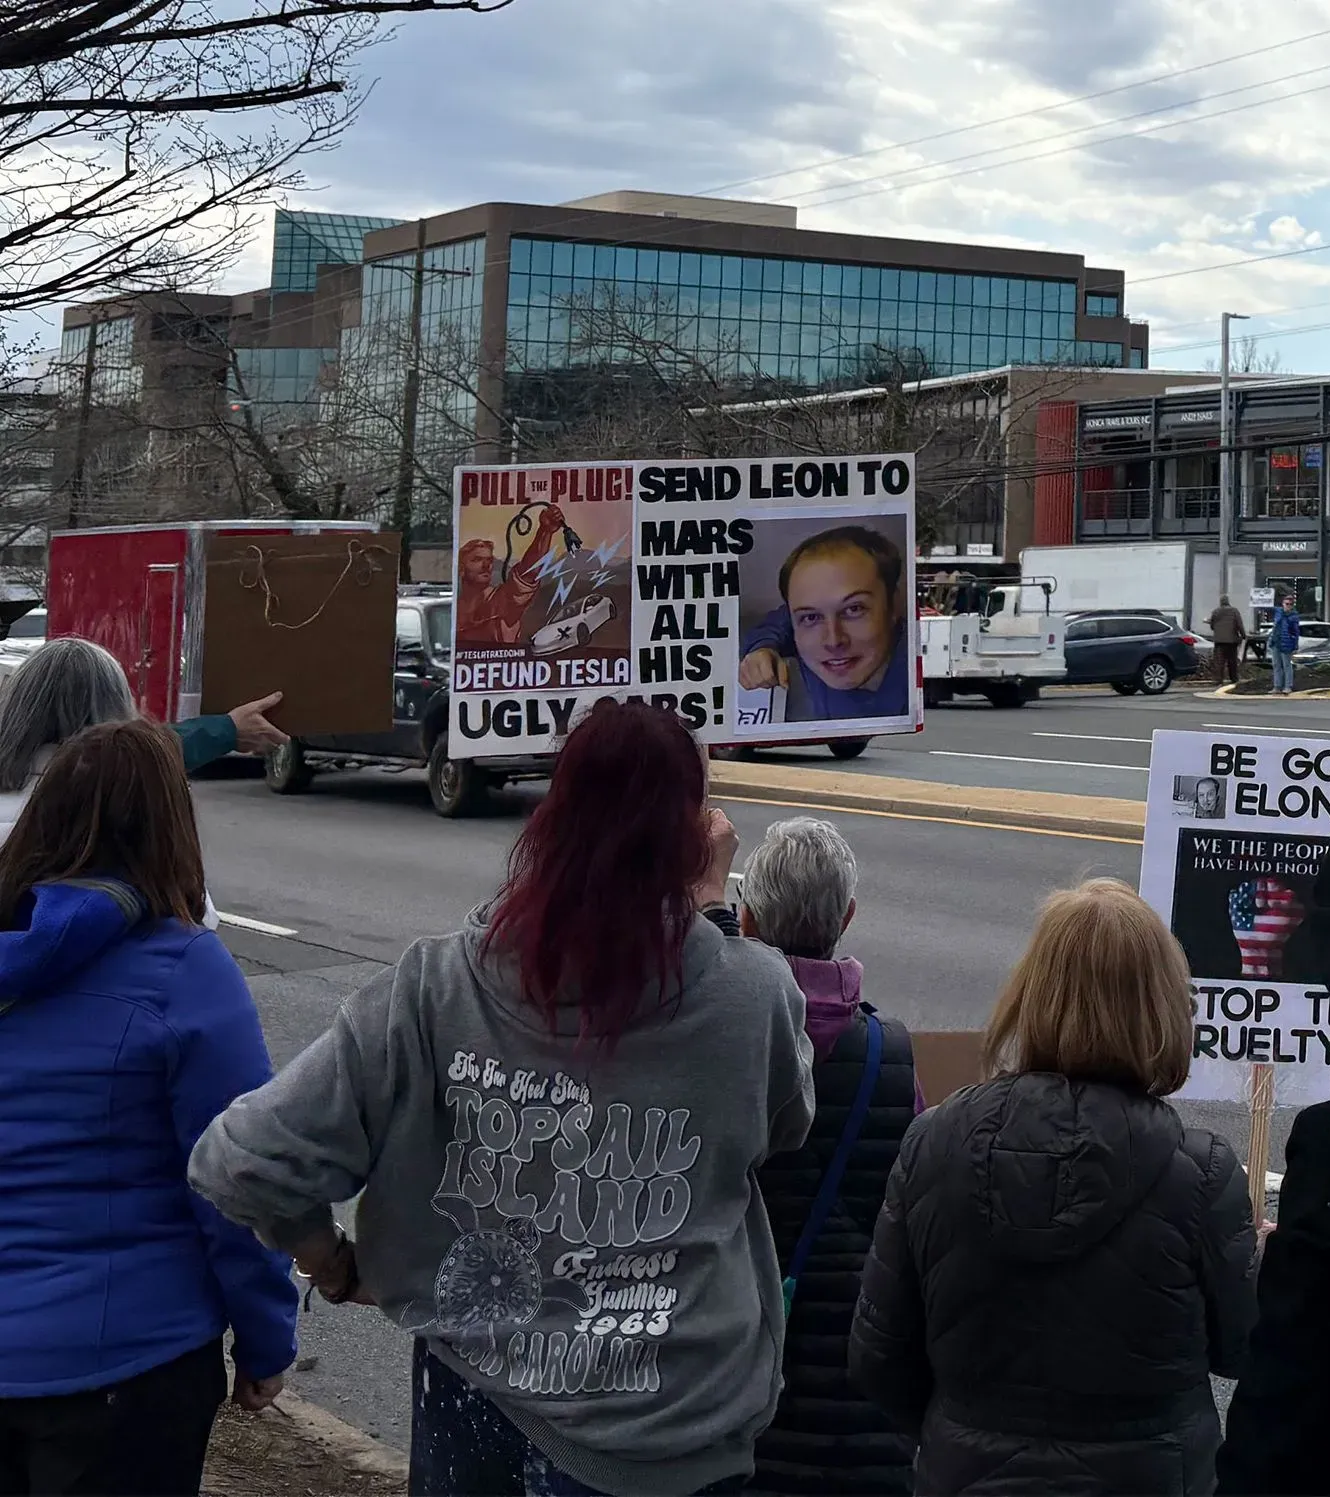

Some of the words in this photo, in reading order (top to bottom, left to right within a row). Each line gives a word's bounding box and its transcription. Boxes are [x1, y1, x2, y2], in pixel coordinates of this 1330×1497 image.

[461, 472, 531, 506] PULL
[530, 480, 548, 492] THE
[551, 467, 633, 503] PLUG!
[638, 465, 741, 503] SEND
[750, 462, 848, 499] LEON
[857, 460, 910, 496] TO
[641, 518, 754, 556] MARS
[637, 561, 740, 600] WITH
[650, 603, 729, 641] ALL
[455, 661, 551, 690] DEFUND
[556, 657, 629, 685] TESLA
[639, 644, 712, 684] HIS
[459, 697, 578, 739] UGLY
[593, 686, 724, 730] RS!
[1210, 743, 1258, 778] BE
[1193, 837, 1222, 853] WE
[1228, 839, 1267, 857] THE
[1273, 842, 1329, 860] PEOP
[1194, 857, 1236, 870] HAVE
[1239, 859, 1272, 872] HAD
[1276, 862, 1320, 876] ENOU
[448, 1051, 480, 1082] The
[510, 1069, 548, 1105] Heel
[446, 1086, 700, 1181] TOPSAIL
[434, 1141, 691, 1248] ISLAND
[552, 1246, 680, 1280] Endless
[579, 1280, 677, 1319] Summer
[574, 1310, 673, 1336] 1963
[508, 1331, 660, 1394] CAROLINA
